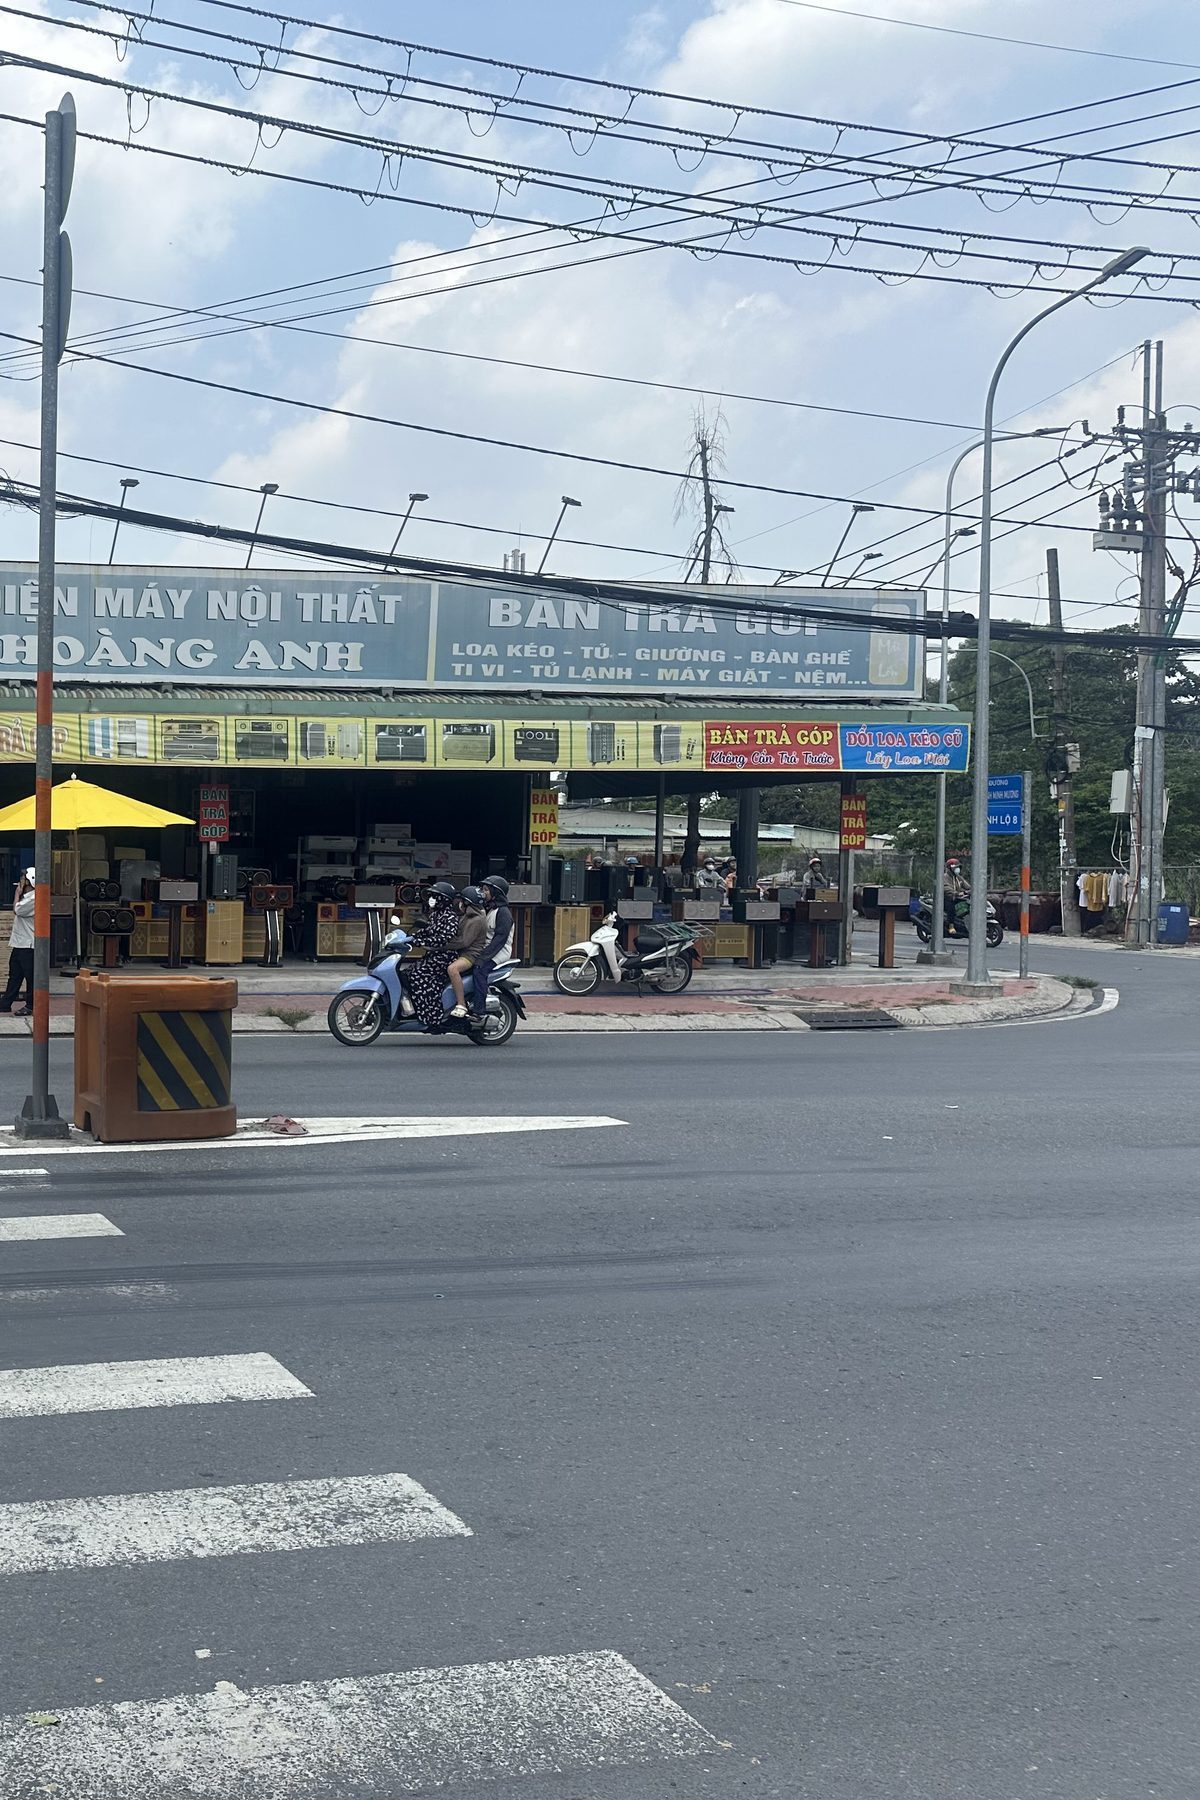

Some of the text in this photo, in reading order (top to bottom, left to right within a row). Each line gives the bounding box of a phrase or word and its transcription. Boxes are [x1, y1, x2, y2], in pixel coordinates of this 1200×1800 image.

[94, 582, 193, 619] MÁY
[207, 584, 282, 628] NỘI
[296, 584, 402, 624] THẤT
[233, 639, 365, 672] ANH
[452, 643, 499, 657] LOA
[507, 642, 555, 658] KÉO
[581, 643, 610, 660] TỦ
[635, 646, 726, 663] GIƯỜNG
[750, 648, 798, 664] BÀN
[806, 649, 852, 665] GHẾ
[451, 663, 473, 676] TI
[481, 664, 504, 677] VI
[530, 661, 560, 678] TỦ
[568, 666, 632, 682] LẠNH
[657, 667, 710, 682] MÁY
[718, 669, 771, 685] GIẶT
[710, 723, 834, 746] BÁN TRẢ GÓP
[846, 724, 962, 748] ĐỔI LOA KÉO CŨ
[710, 751, 746, 769] Không
[751, 749, 774, 764] Cần
[866, 751, 892, 769] Lấy
[894, 752, 921, 765] Loa
[201, 787, 227, 800] BÁN
[532, 791, 557, 805] BÁN
[202, 804, 227, 819] TRẢ
[842, 798, 865, 811] BÁN
[532, 809, 557, 824] TRẢ
[843, 814, 864, 828] TRẢ
[1012, 815, 1018, 825] 8
[201, 823, 227, 838] GÓP
[531, 829, 556, 843] GÓP
[842, 833, 865, 845] GÓP
